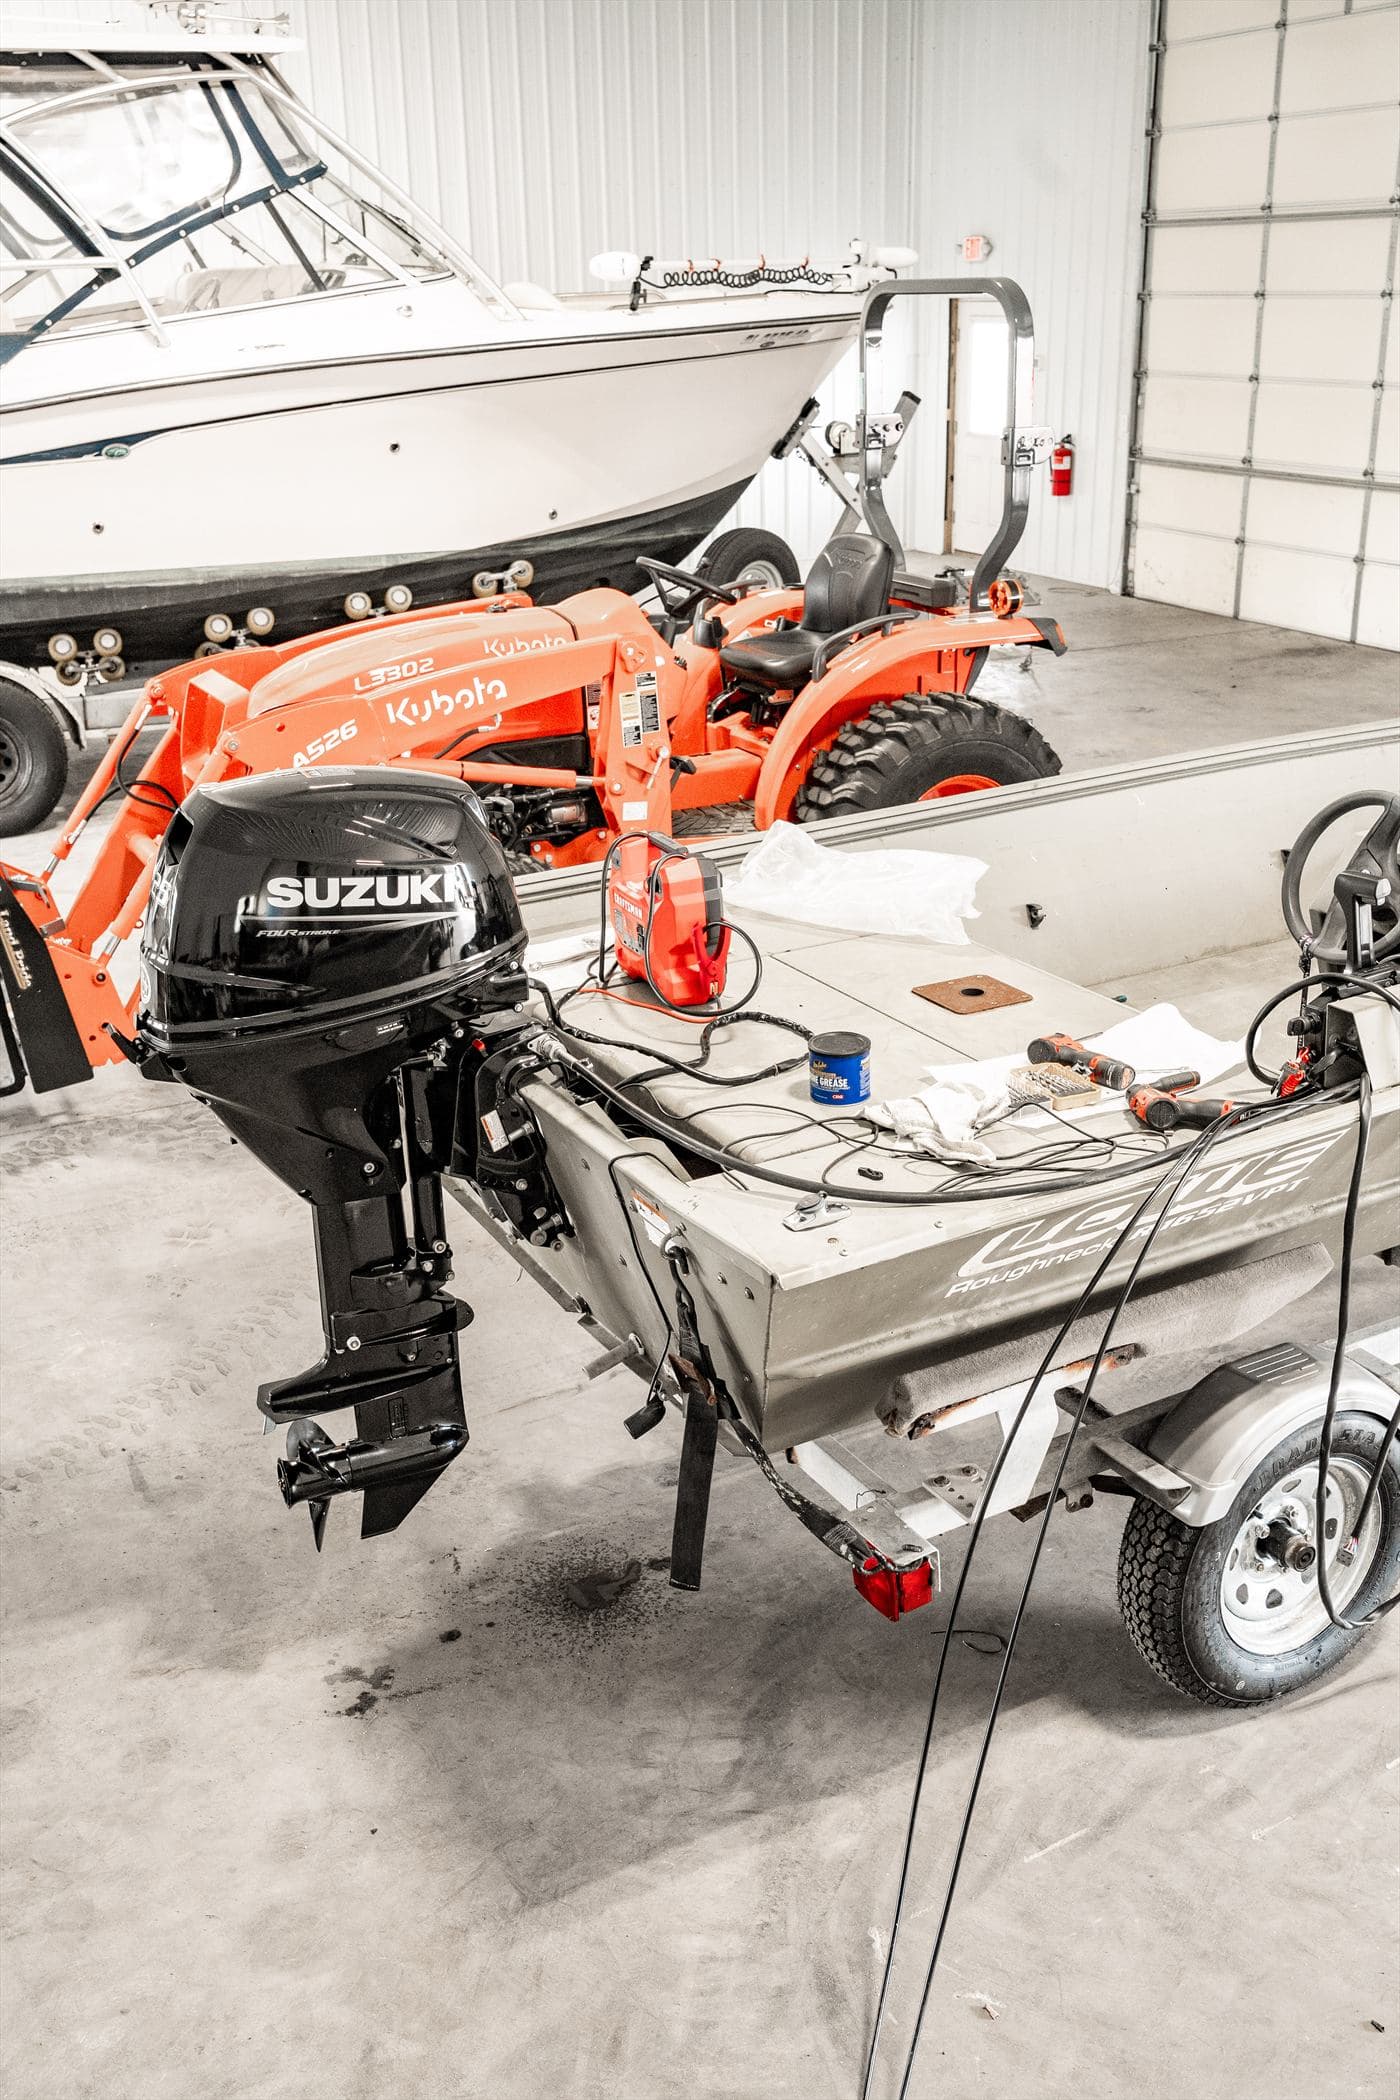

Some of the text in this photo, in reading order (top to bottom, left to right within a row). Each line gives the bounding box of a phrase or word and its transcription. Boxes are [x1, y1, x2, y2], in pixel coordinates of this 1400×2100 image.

[354, 657, 434, 691] L3302
[386, 676, 508, 726] Kubota
[276, 719, 358, 769] A526
[256, 929, 298, 938] FOUR
[819, 1076, 848, 1089] GREASE
[944, 1236, 1118, 1299] Roughneck
